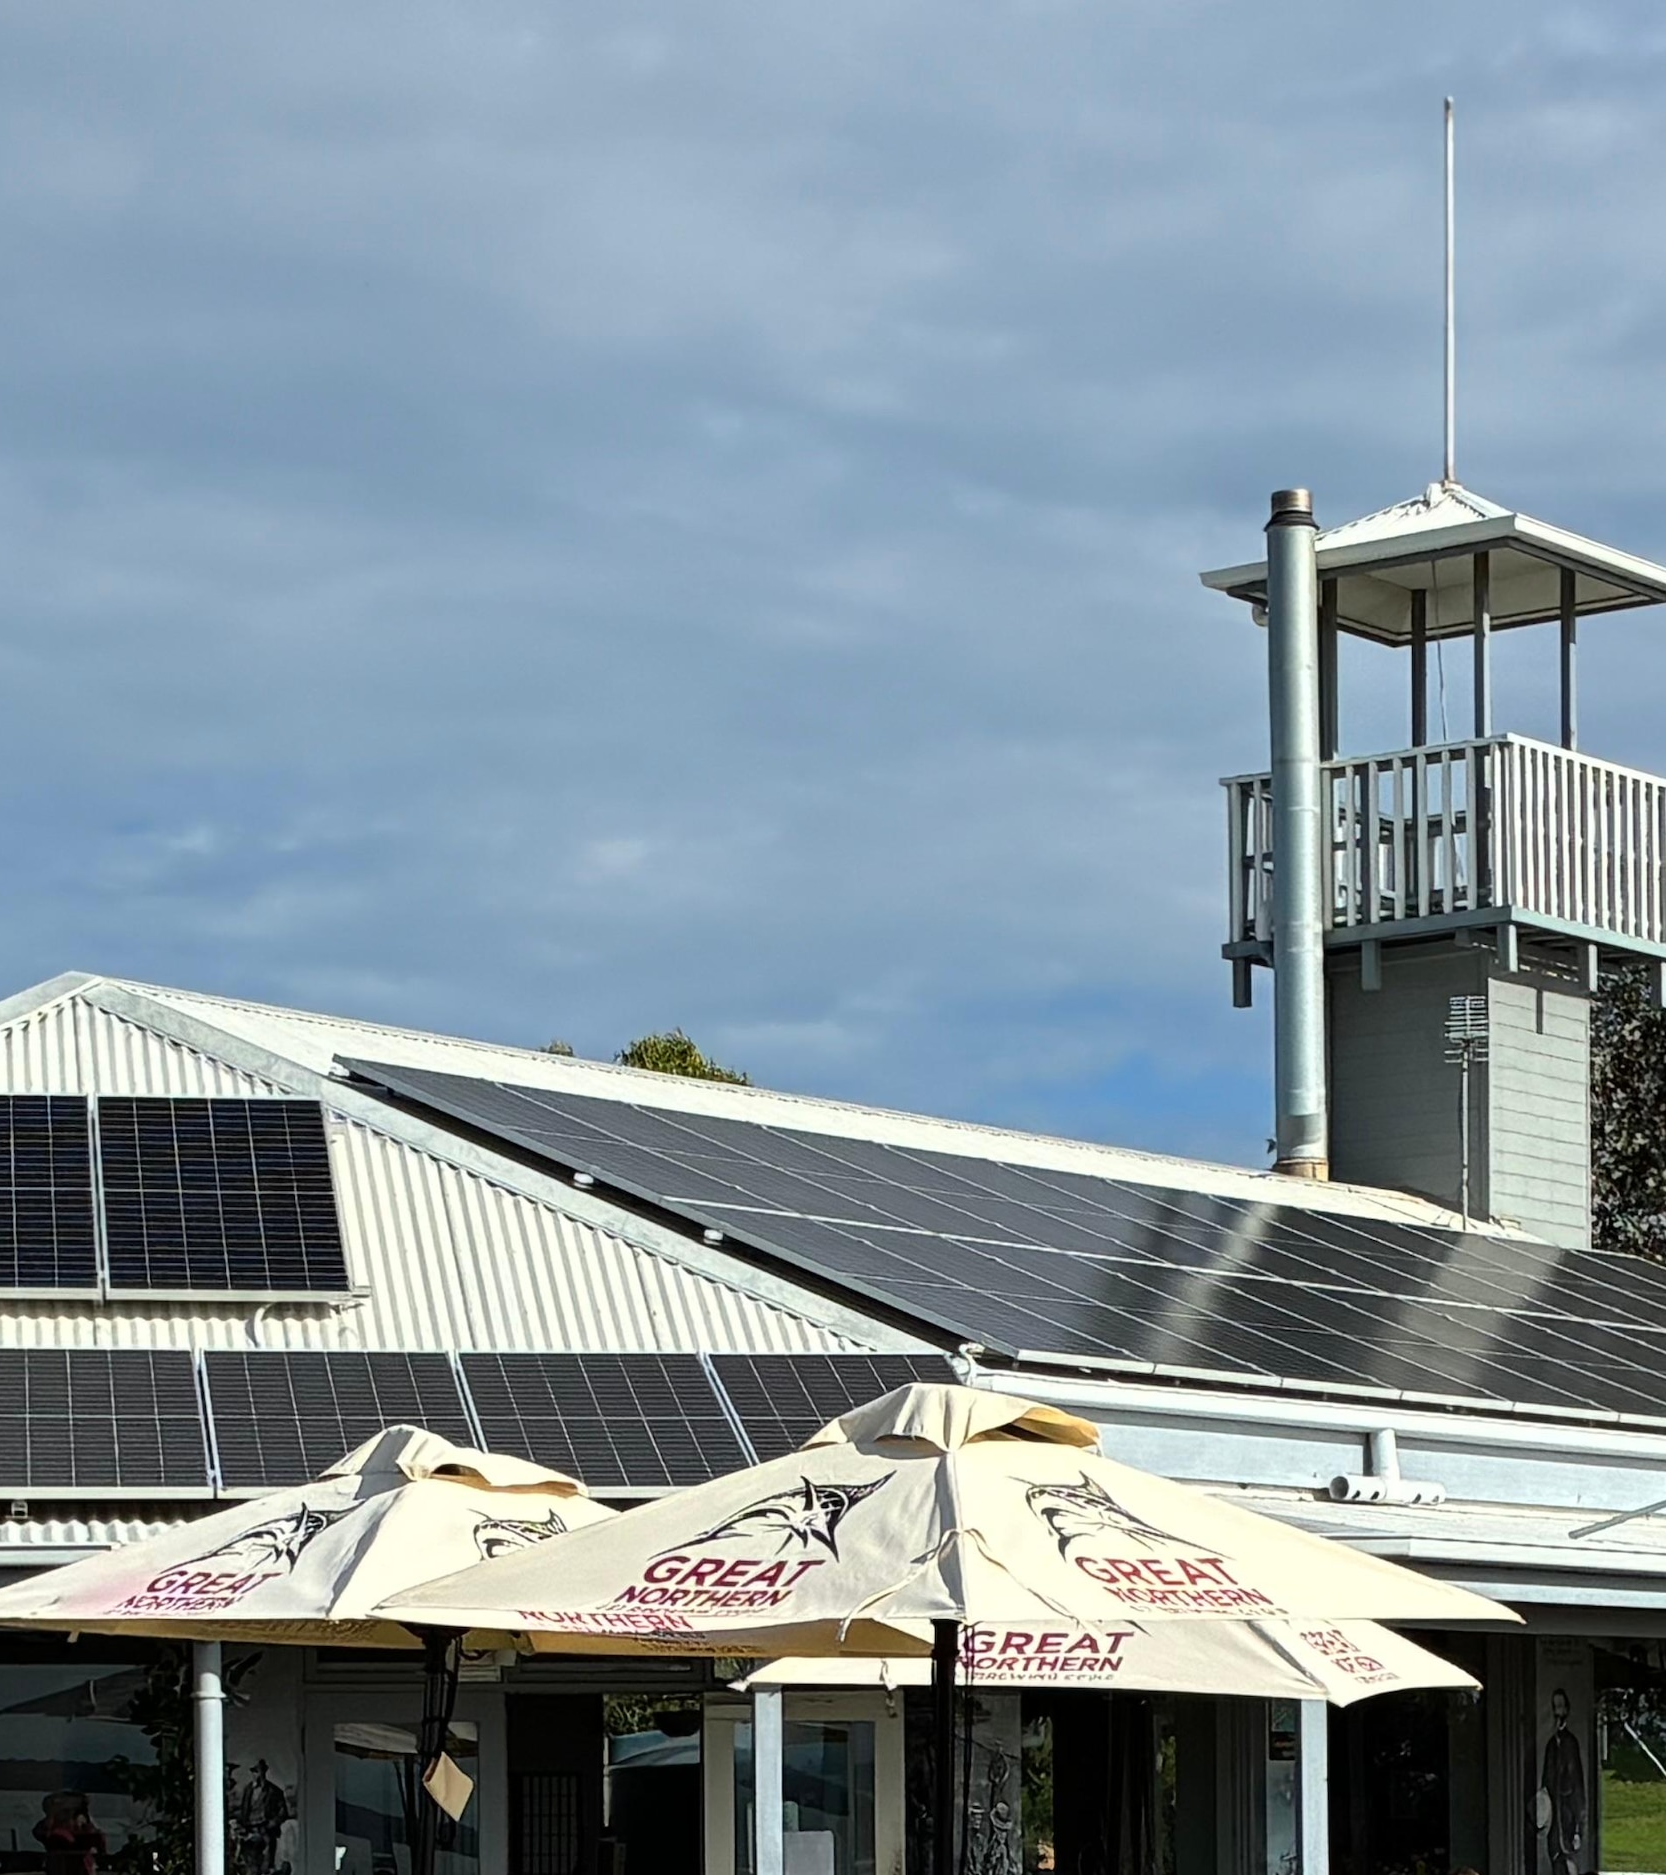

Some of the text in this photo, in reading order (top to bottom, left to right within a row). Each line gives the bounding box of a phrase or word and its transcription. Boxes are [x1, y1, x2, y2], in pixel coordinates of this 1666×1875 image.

[146, 1570, 283, 1595] GREAT
[643, 1556, 825, 1587] GREAT
[1075, 1556, 1239, 1586] GREAT
[614, 1585, 793, 1608] NORTHERN
[1102, 1586, 1275, 1607] NORTHERN
[962, 1631, 1135, 1655] GREAT
[955, 1656, 1124, 1672] NORTHERN
